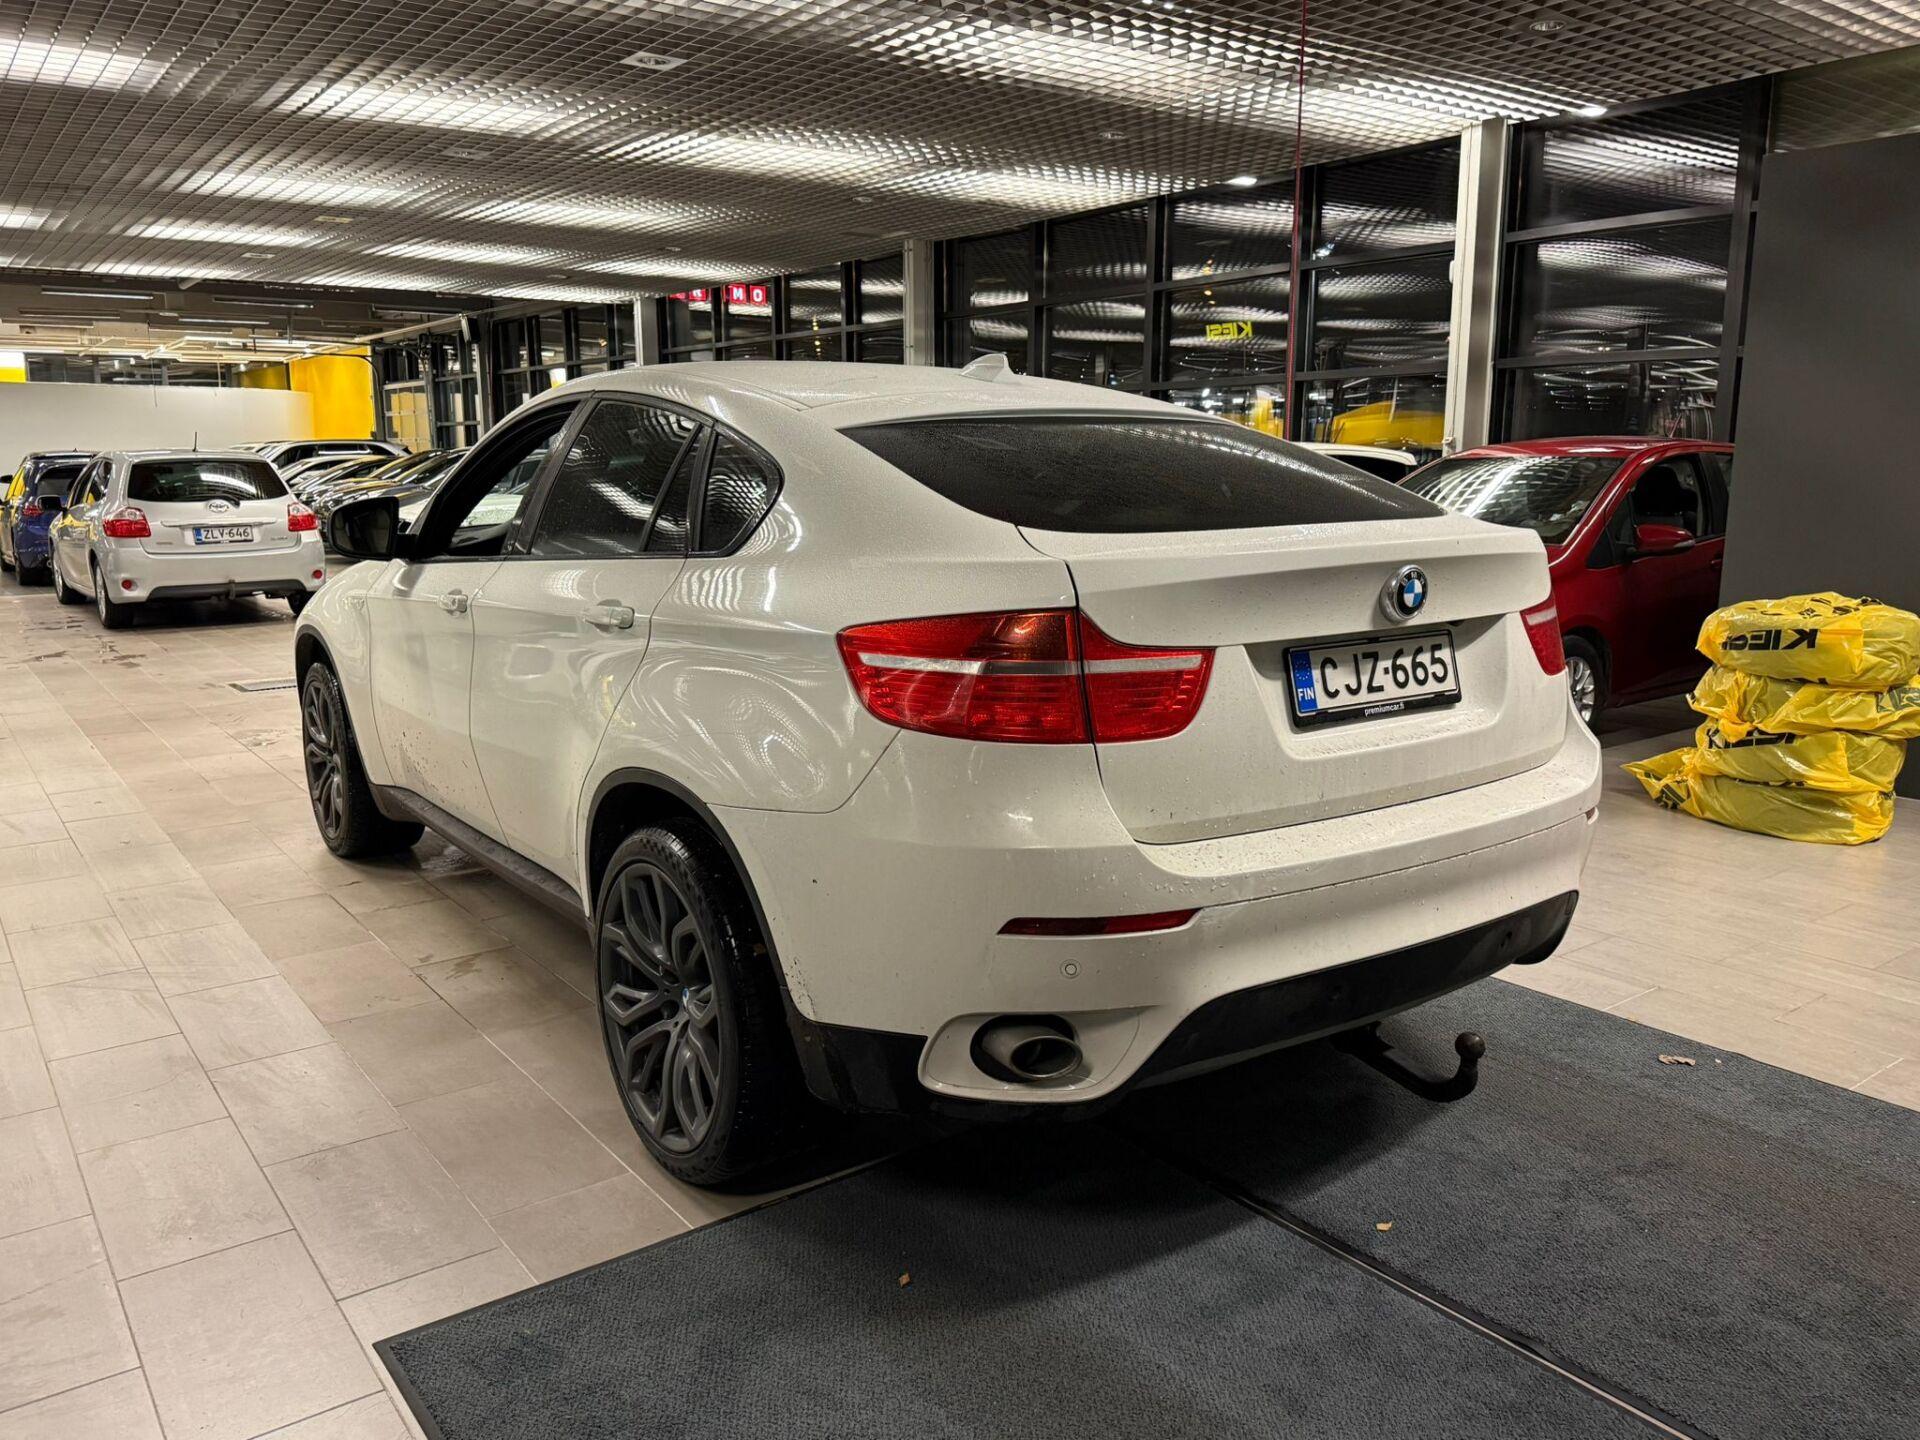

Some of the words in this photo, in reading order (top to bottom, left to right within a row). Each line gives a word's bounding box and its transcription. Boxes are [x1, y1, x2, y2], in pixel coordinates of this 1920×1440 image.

[203, 528, 250, 540] ZLV-646
[1319, 643, 1449, 699] CJZ-665
[1297, 686, 1315, 701] FIN
[1364, 701, 1405, 717] premiumcar.fi
